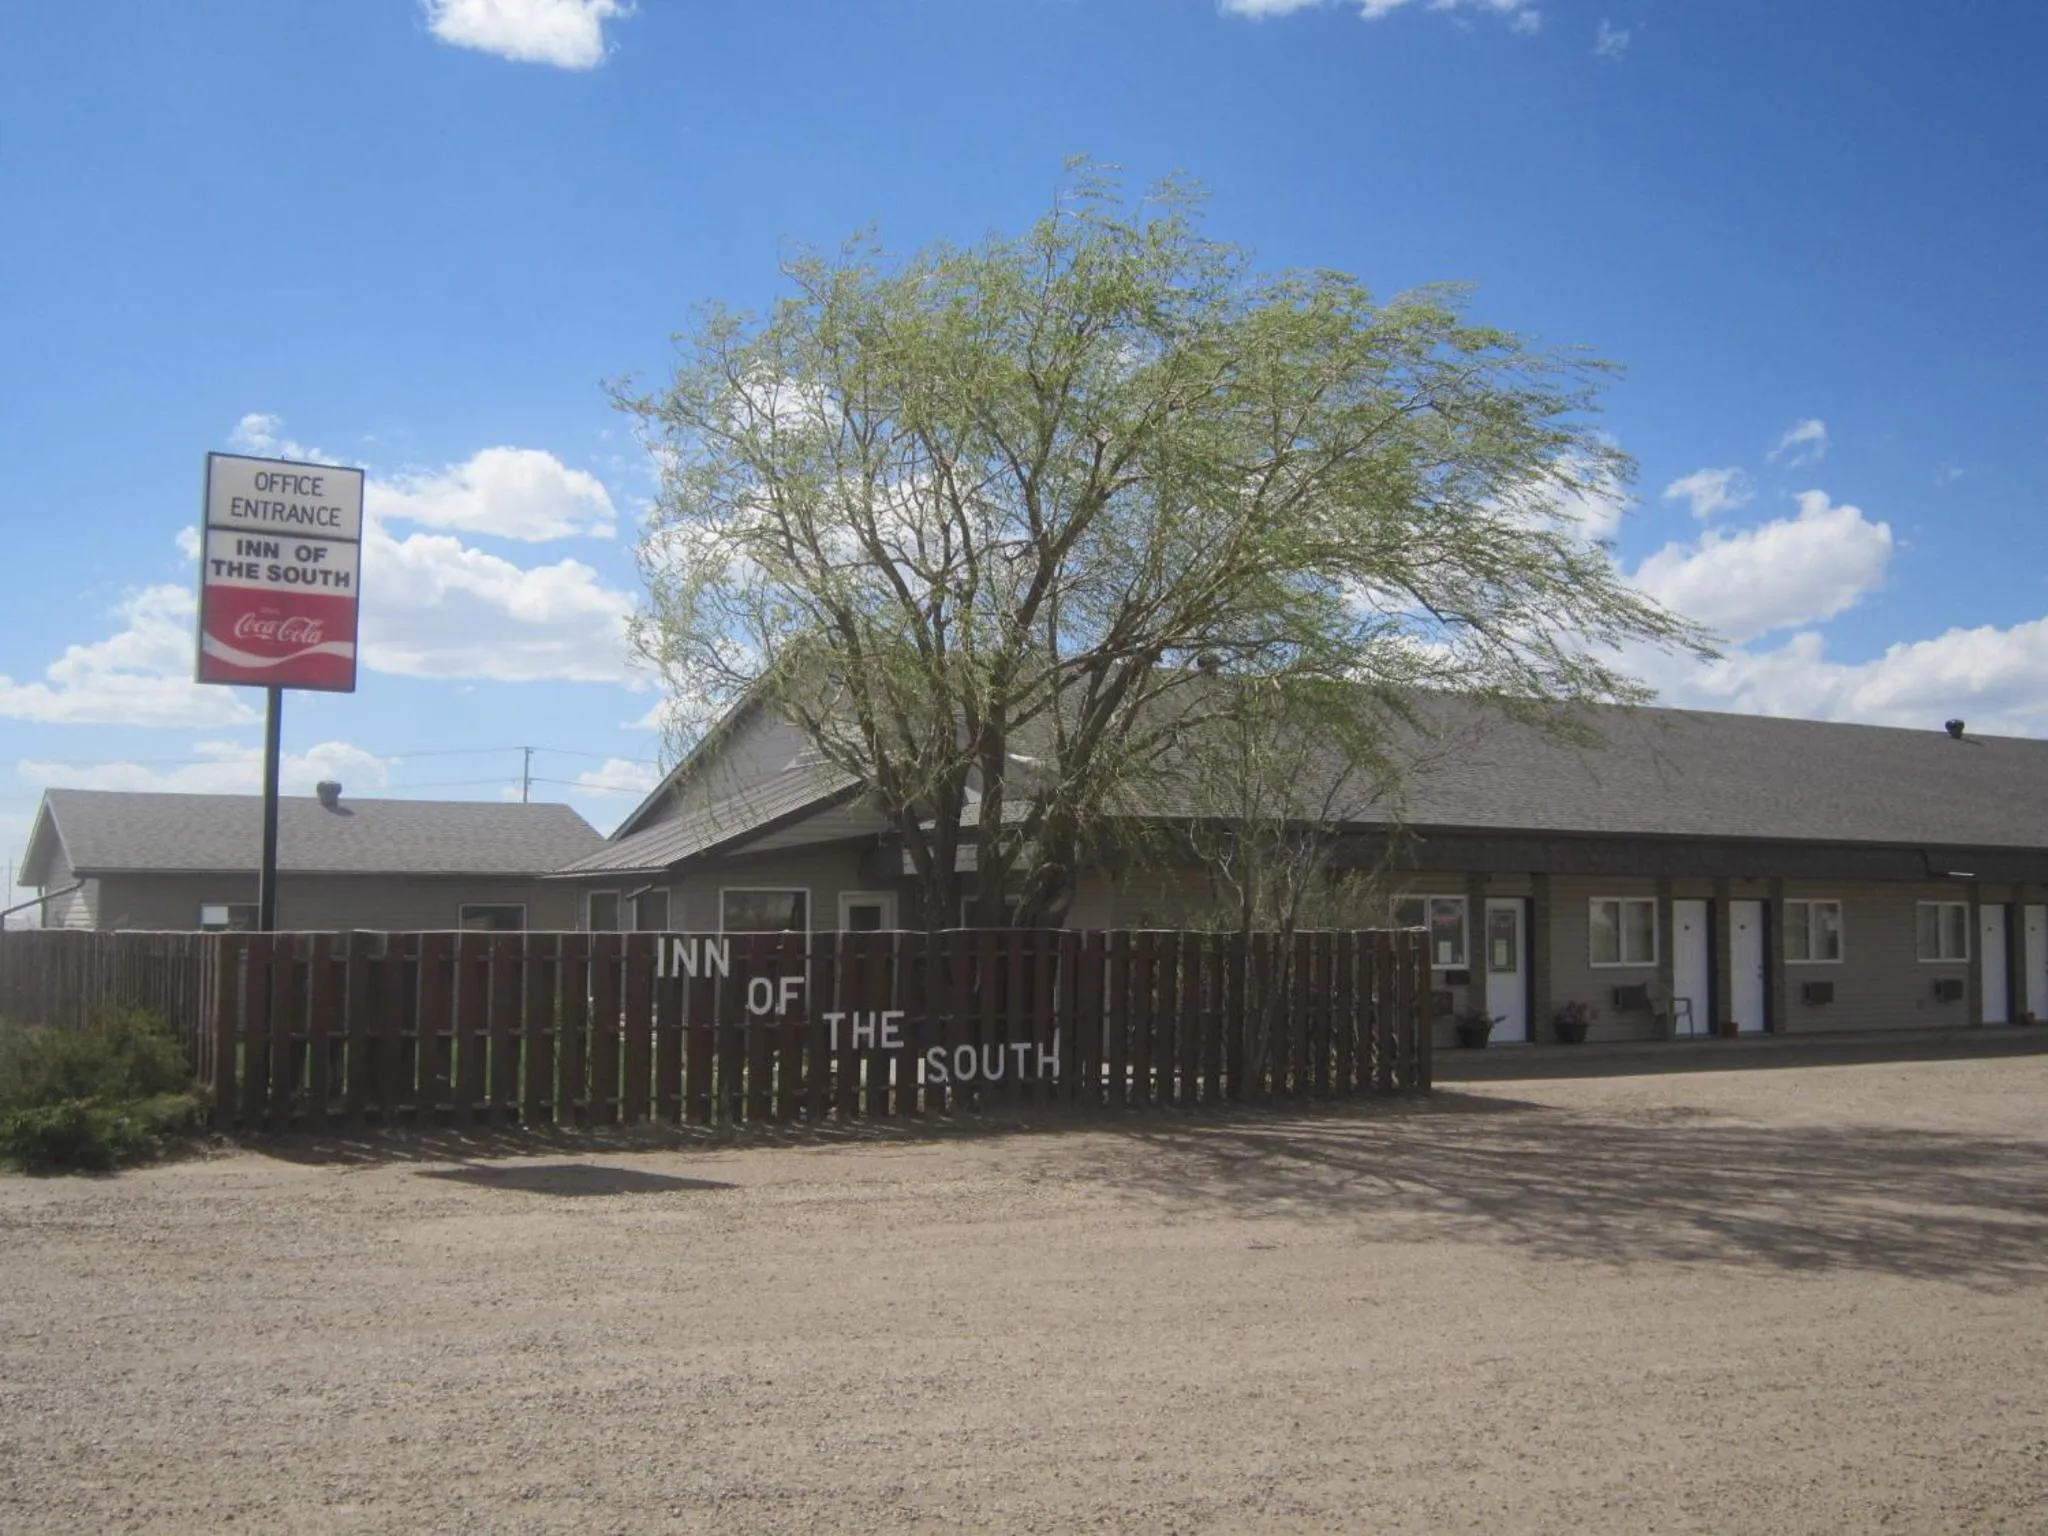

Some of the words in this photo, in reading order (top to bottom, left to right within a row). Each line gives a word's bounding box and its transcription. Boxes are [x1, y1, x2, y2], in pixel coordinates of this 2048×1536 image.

[254, 471, 324, 497] OFFICE
[230, 497, 342, 527] ENTRANCE
[236, 539, 280, 559] INN
[294, 545, 328, 563] OF
[210, 559, 260, 580] THE
[267, 564, 350, 588] SOUTH
[657, 937, 730, 978] INN
[747, 976, 805, 1015] OF
[822, 1010, 905, 1050] THE
[926, 1042, 1060, 1083] SOUTH
